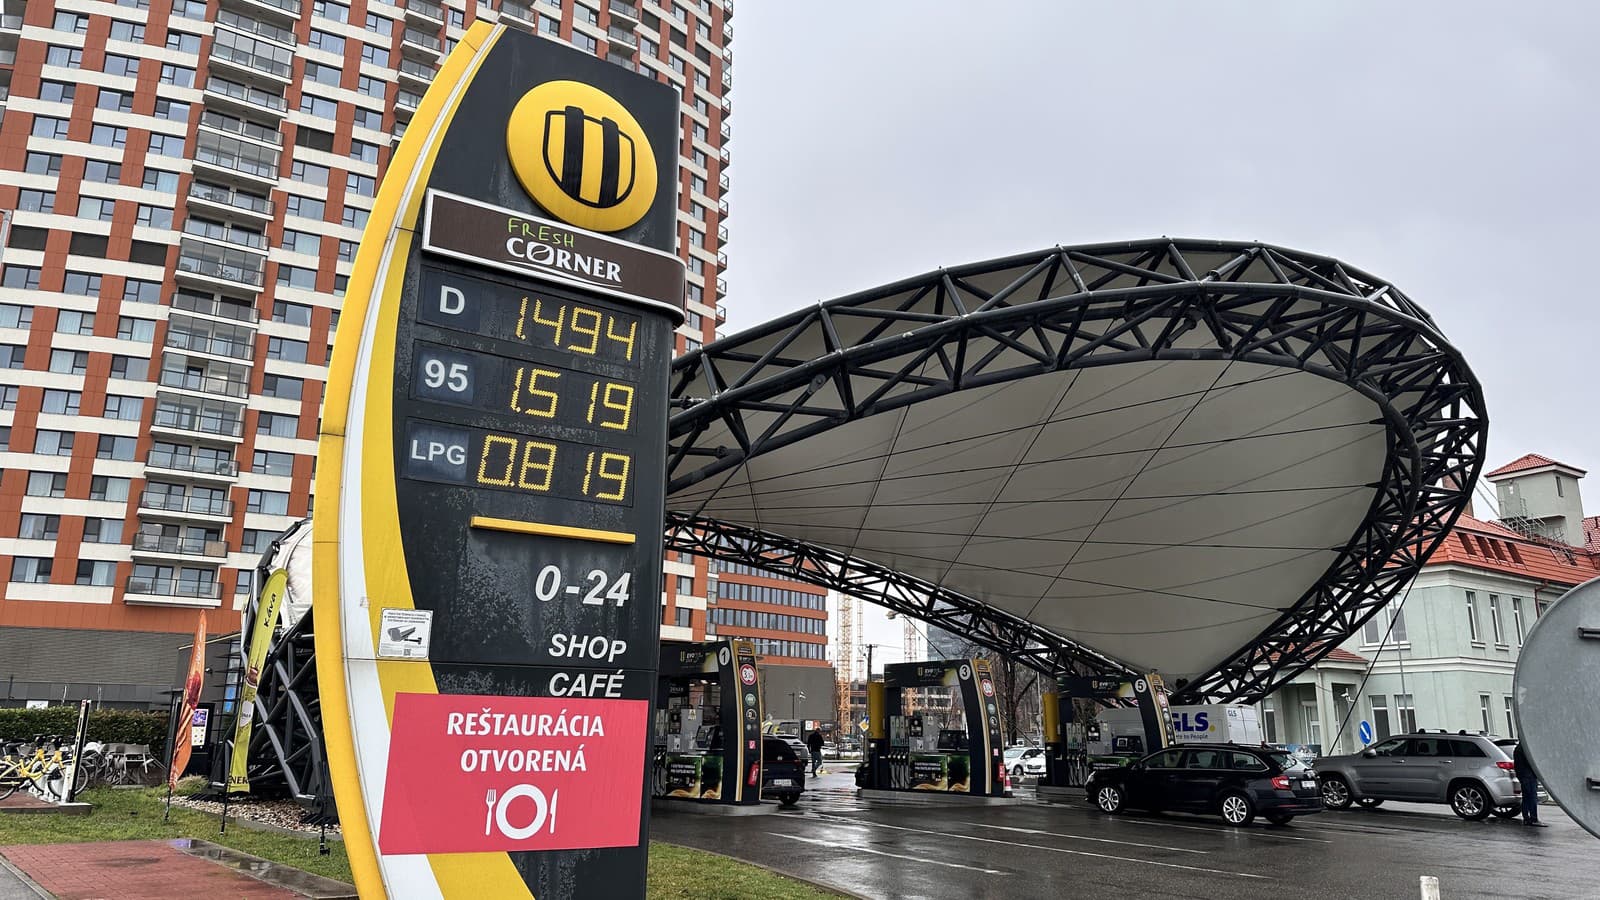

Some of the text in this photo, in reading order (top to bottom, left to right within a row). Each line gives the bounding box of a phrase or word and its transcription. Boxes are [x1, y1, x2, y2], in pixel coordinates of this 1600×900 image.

[507, 217, 575, 249] FRESH
[505, 237, 623, 283] CORNER
[439, 285, 466, 315] D
[515, 296, 637, 361] 1.494
[424, 359, 469, 392] 95
[411, 439, 466, 466] LPG
[534, 565, 632, 607] 0-24
[548, 633, 628, 663] SHOP
[721, 650, 727, 664] 1
[549, 669, 626, 698] CAFÉ
[961, 666, 968, 679] 3
[1136, 680, 1144, 691] 5
[447, 707, 605, 738] REŠTAURÁCIA
[460, 744, 588, 773] OTVORENÁ
